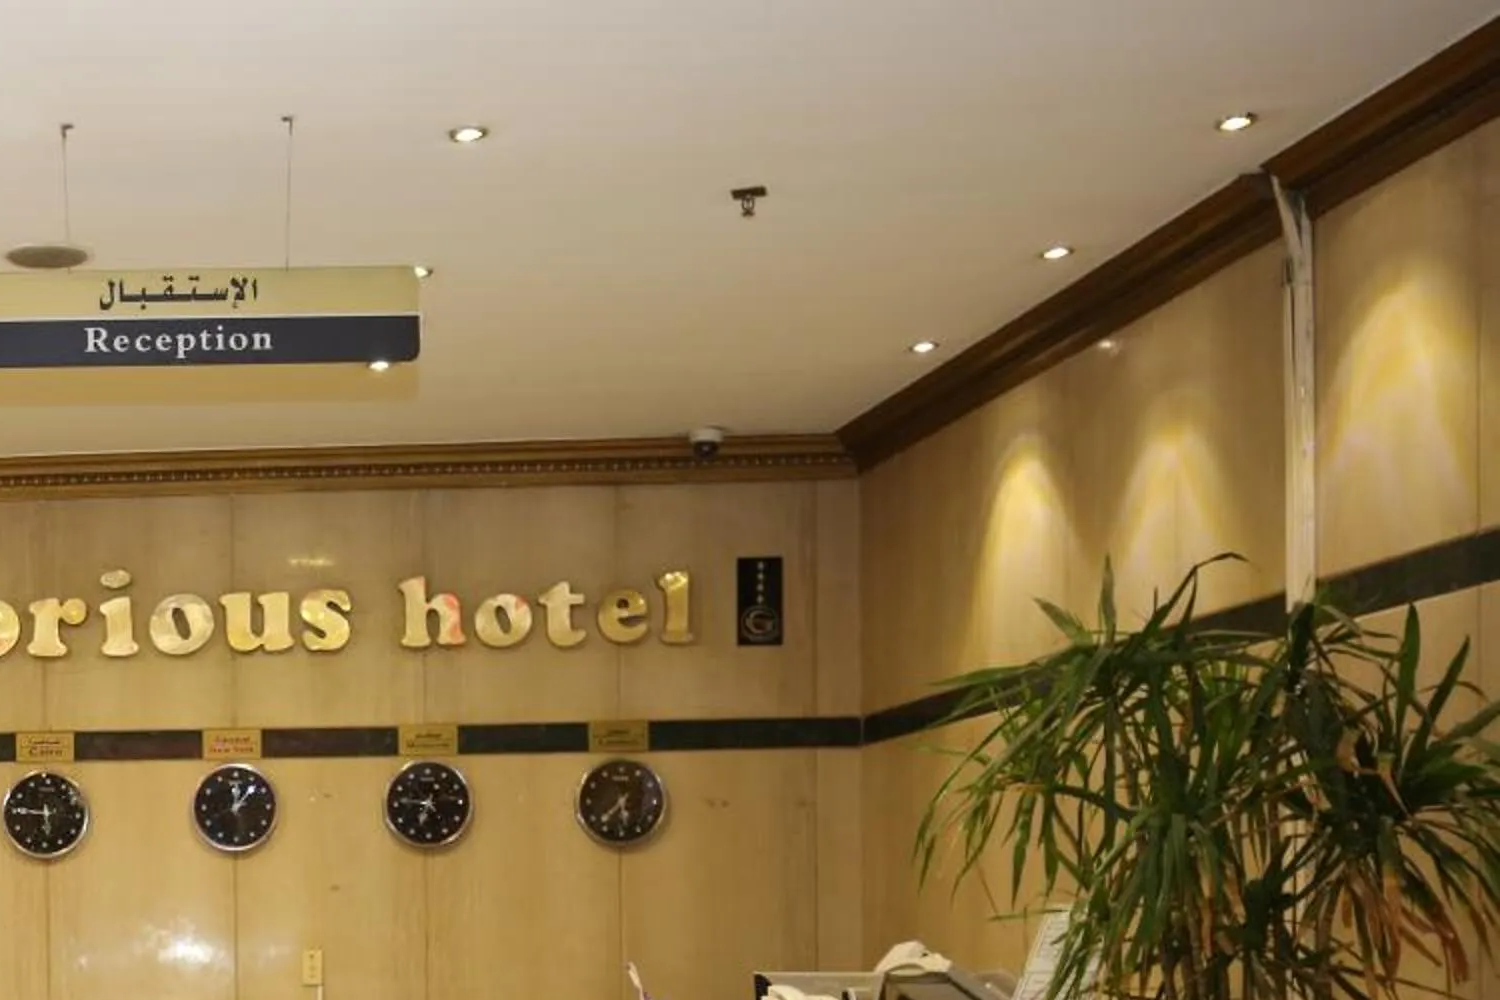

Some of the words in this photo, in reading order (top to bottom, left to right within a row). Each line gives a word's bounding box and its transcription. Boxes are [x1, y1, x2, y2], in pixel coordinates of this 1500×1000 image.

[100, 275, 257, 310] الإستقبال
[84, 325, 272, 359] Reception
[399, 570, 694, 647] hotel
